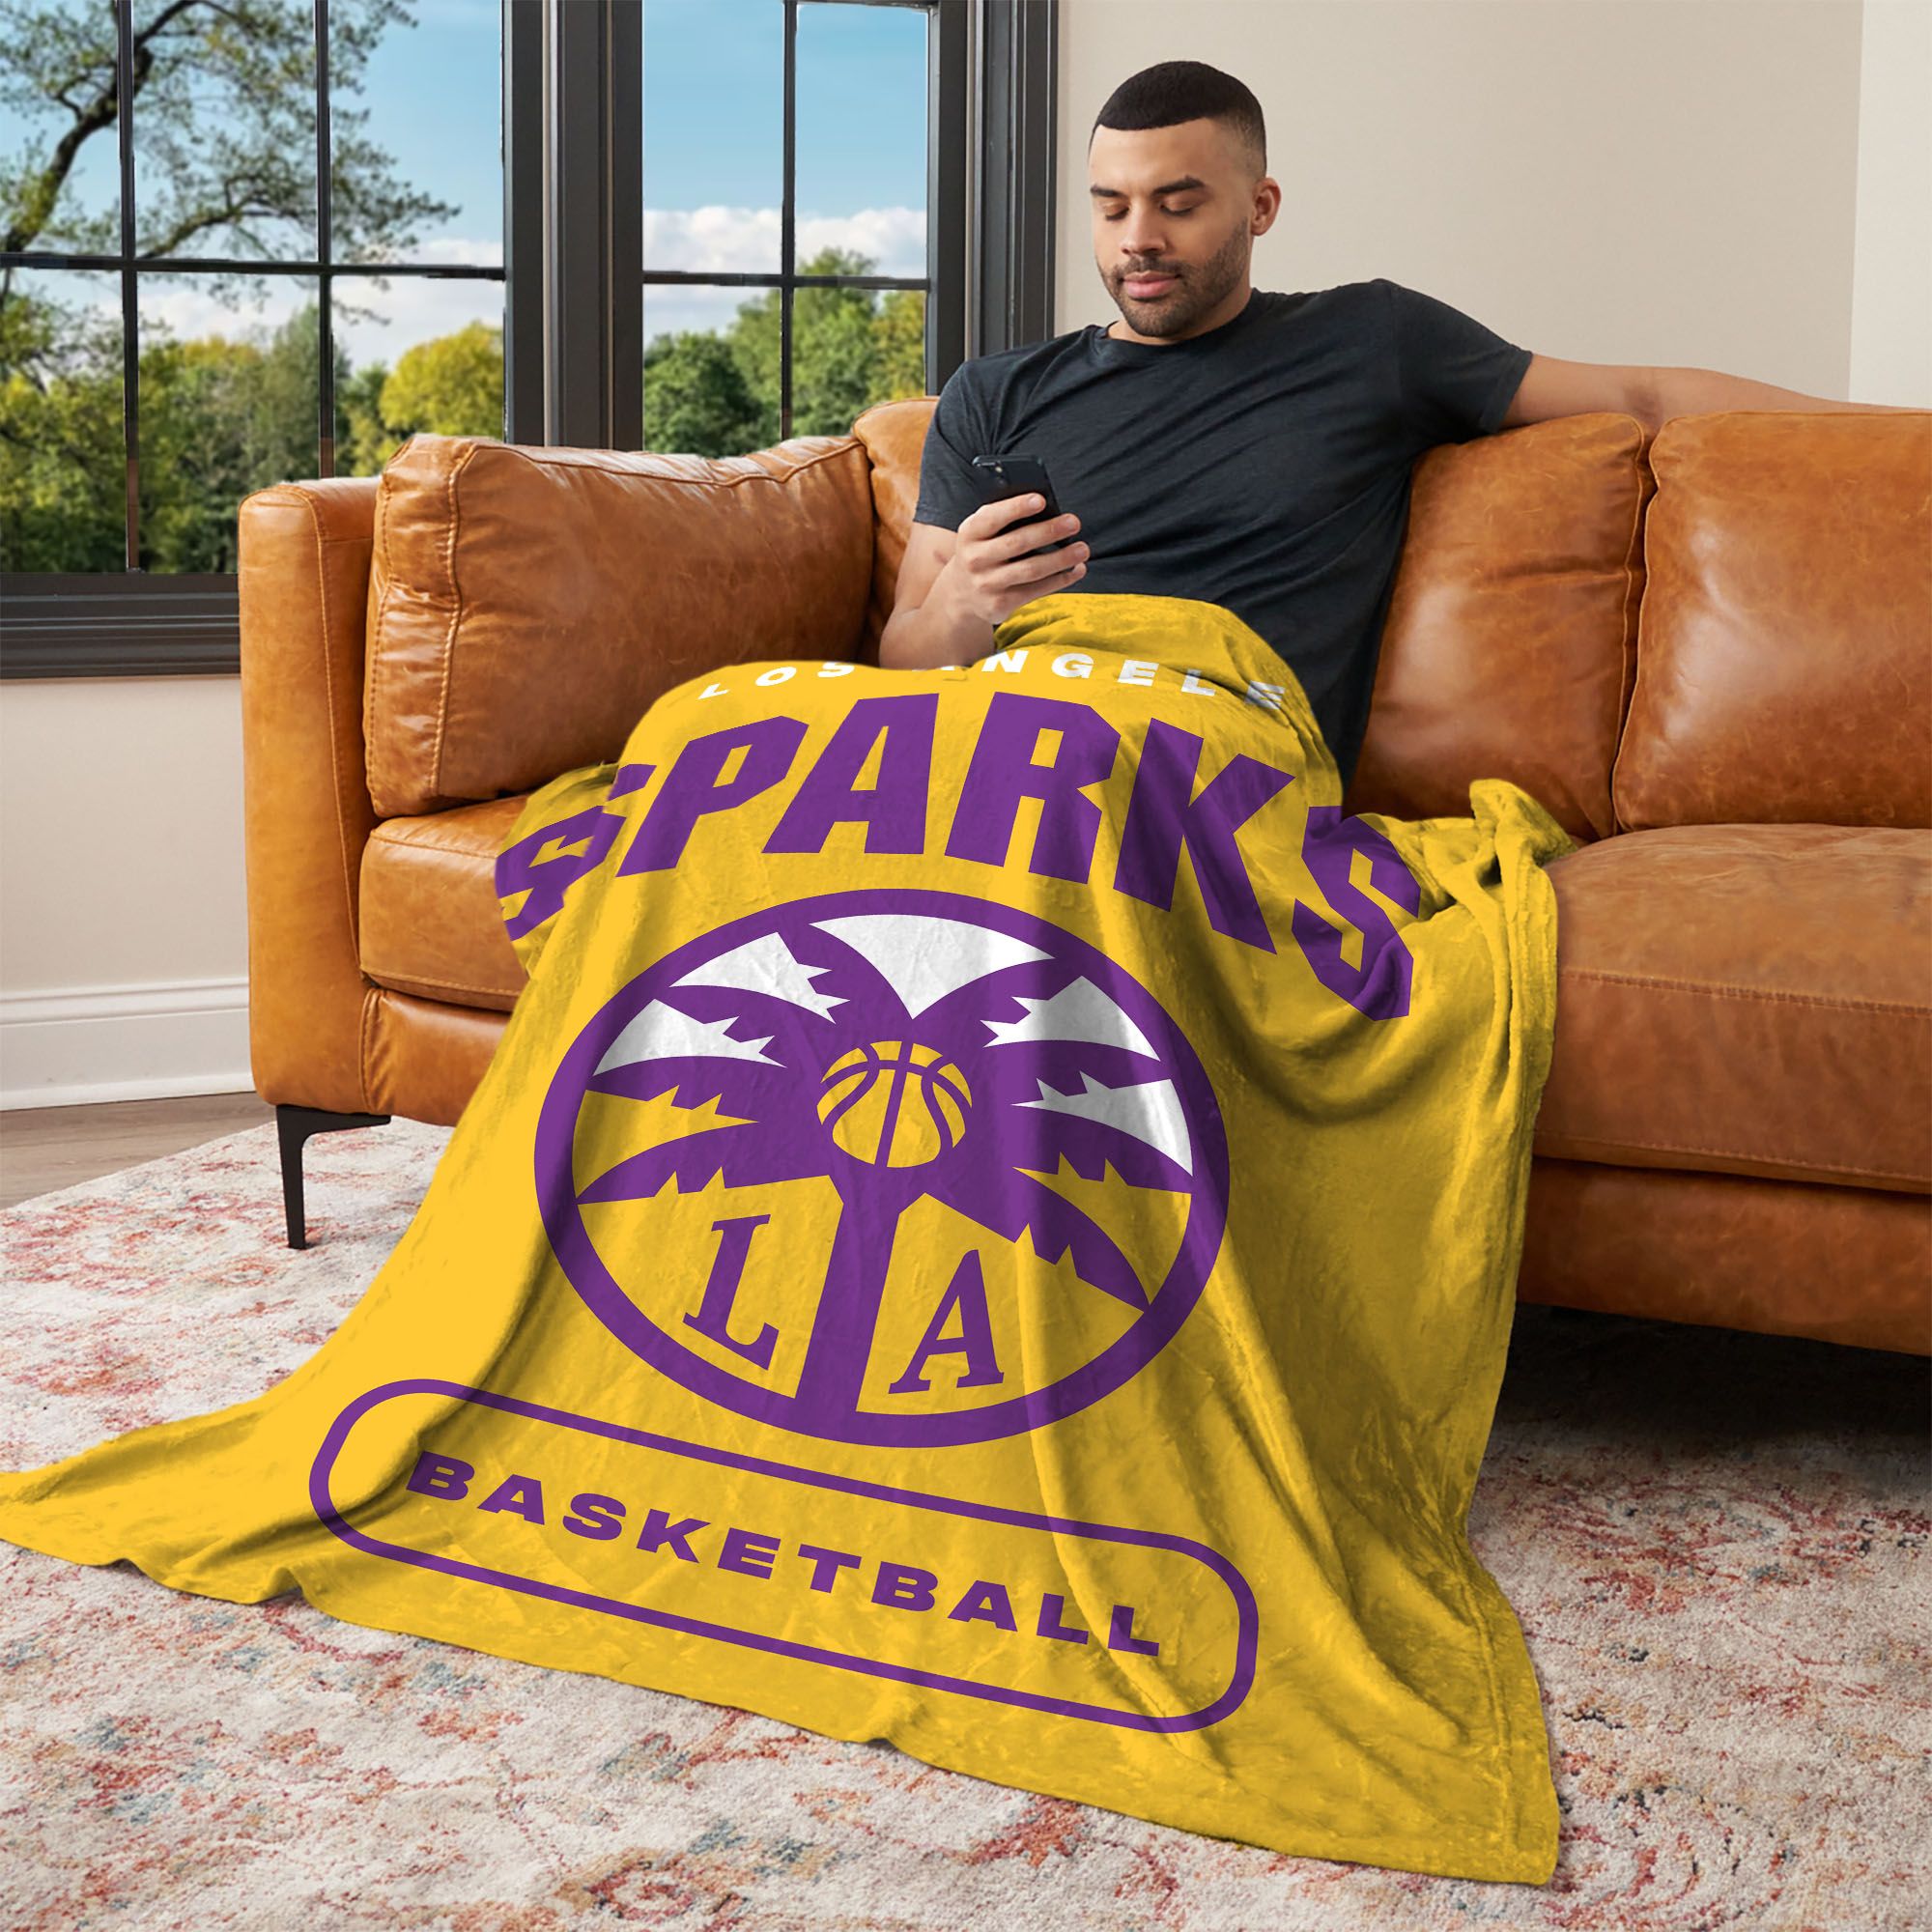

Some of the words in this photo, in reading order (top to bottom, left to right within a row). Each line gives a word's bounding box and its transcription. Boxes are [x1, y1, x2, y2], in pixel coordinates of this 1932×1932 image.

[697, 661, 855, 700] LOS
[911, 649, 1286, 710] NGELE
[495, 691, 1422, 1021] SPARKS
[405, 1451, 1160, 1657] BASKETBALL
